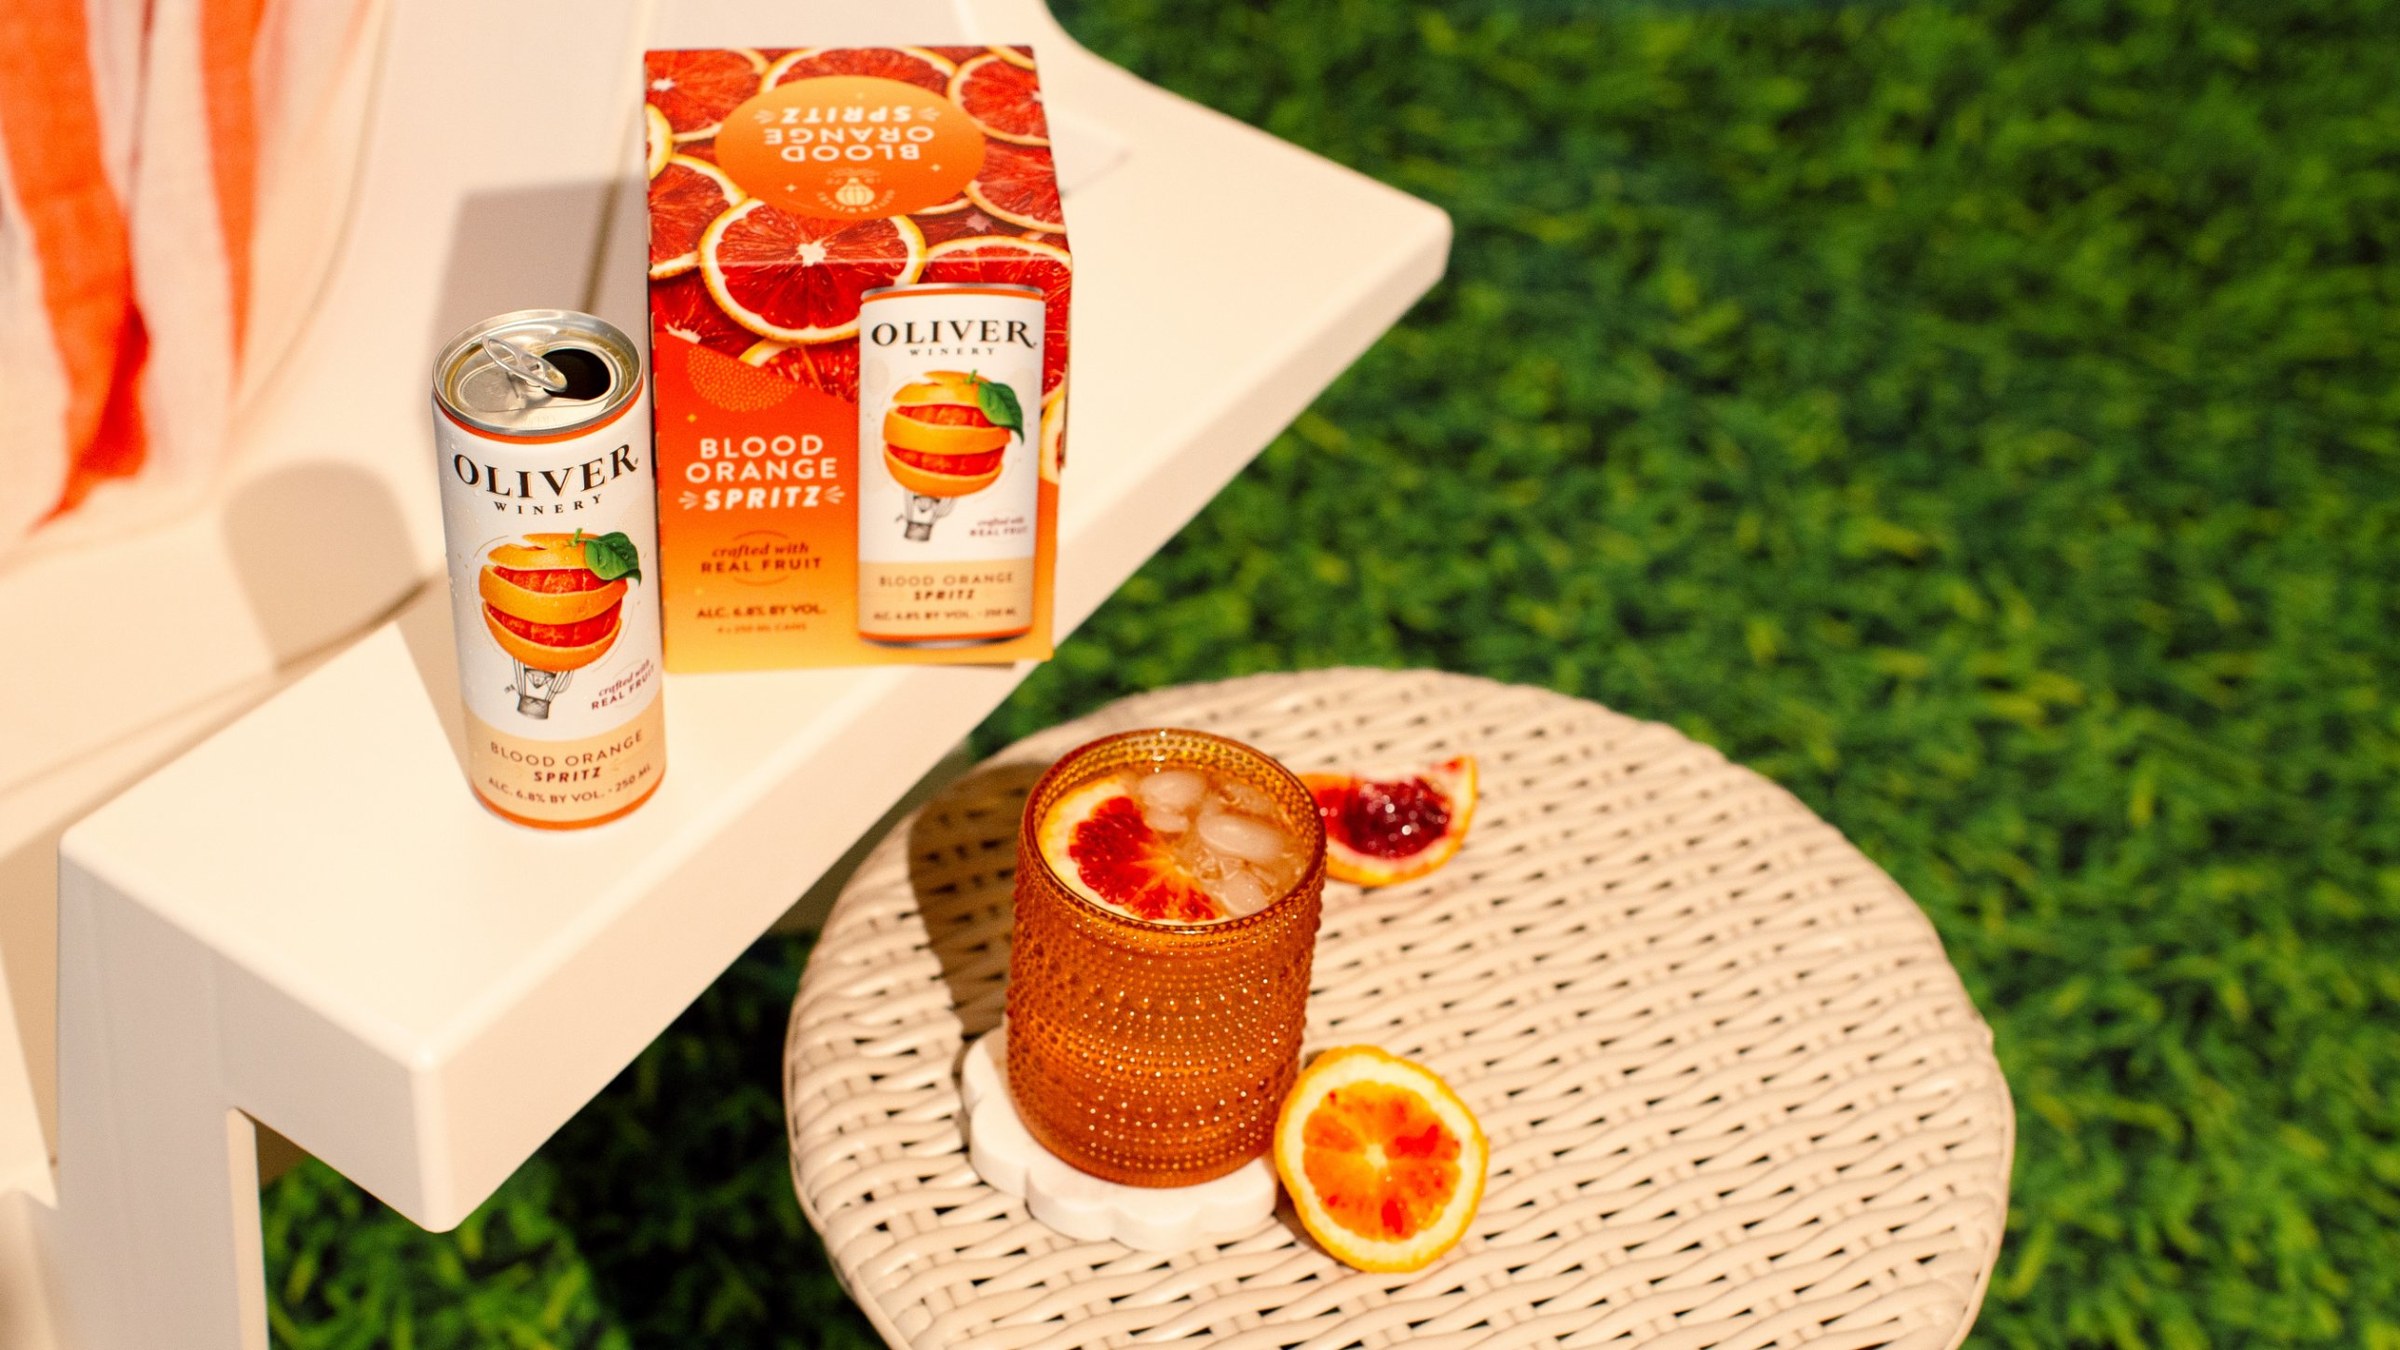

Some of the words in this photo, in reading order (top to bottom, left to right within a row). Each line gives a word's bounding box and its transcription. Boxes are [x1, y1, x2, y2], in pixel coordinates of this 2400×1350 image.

[780, 105, 912, 124] SPRITZ
[763, 126, 935, 145] ORANGE
[780, 143, 920, 162] BLOOD
[871, 320, 1038, 349] OLIVER
[909, 347, 995, 356] WINERY
[700, 434, 823, 460] BLOOD
[453, 443, 640, 499] OLIVER
[685, 457, 837, 484] ORANGE
[493, 493, 602, 516] WINERY
[703, 485, 821, 511] SPRITZ
[969, 528, 1000, 537] REAL
[711, 543, 771, 558] crafted
[775, 541, 809, 555] with
[701, 560, 751, 573] REAL
[761, 556, 821, 571] FRUIT
[879, 575, 935, 587] BLOOD
[943, 572, 1013, 586] ORANGE
[914, 589, 975, 601] SPRITZ
[769, 604, 787, 615] BY
[598, 672, 634, 697] crafted
[591, 691, 625, 711] REAL
[490, 741, 555, 768] BLOOD
[565, 728, 643, 767] ORANGE
[488, 776, 514, 796] ALC.
[516, 789, 546, 803] 6.8%
[550, 794, 567, 804] BY
[571, 790, 605, 803] VOL.
[615, 774, 636, 793] 250
[638, 763, 652, 779] ML
[533, 766, 602, 783] SPRITZ
